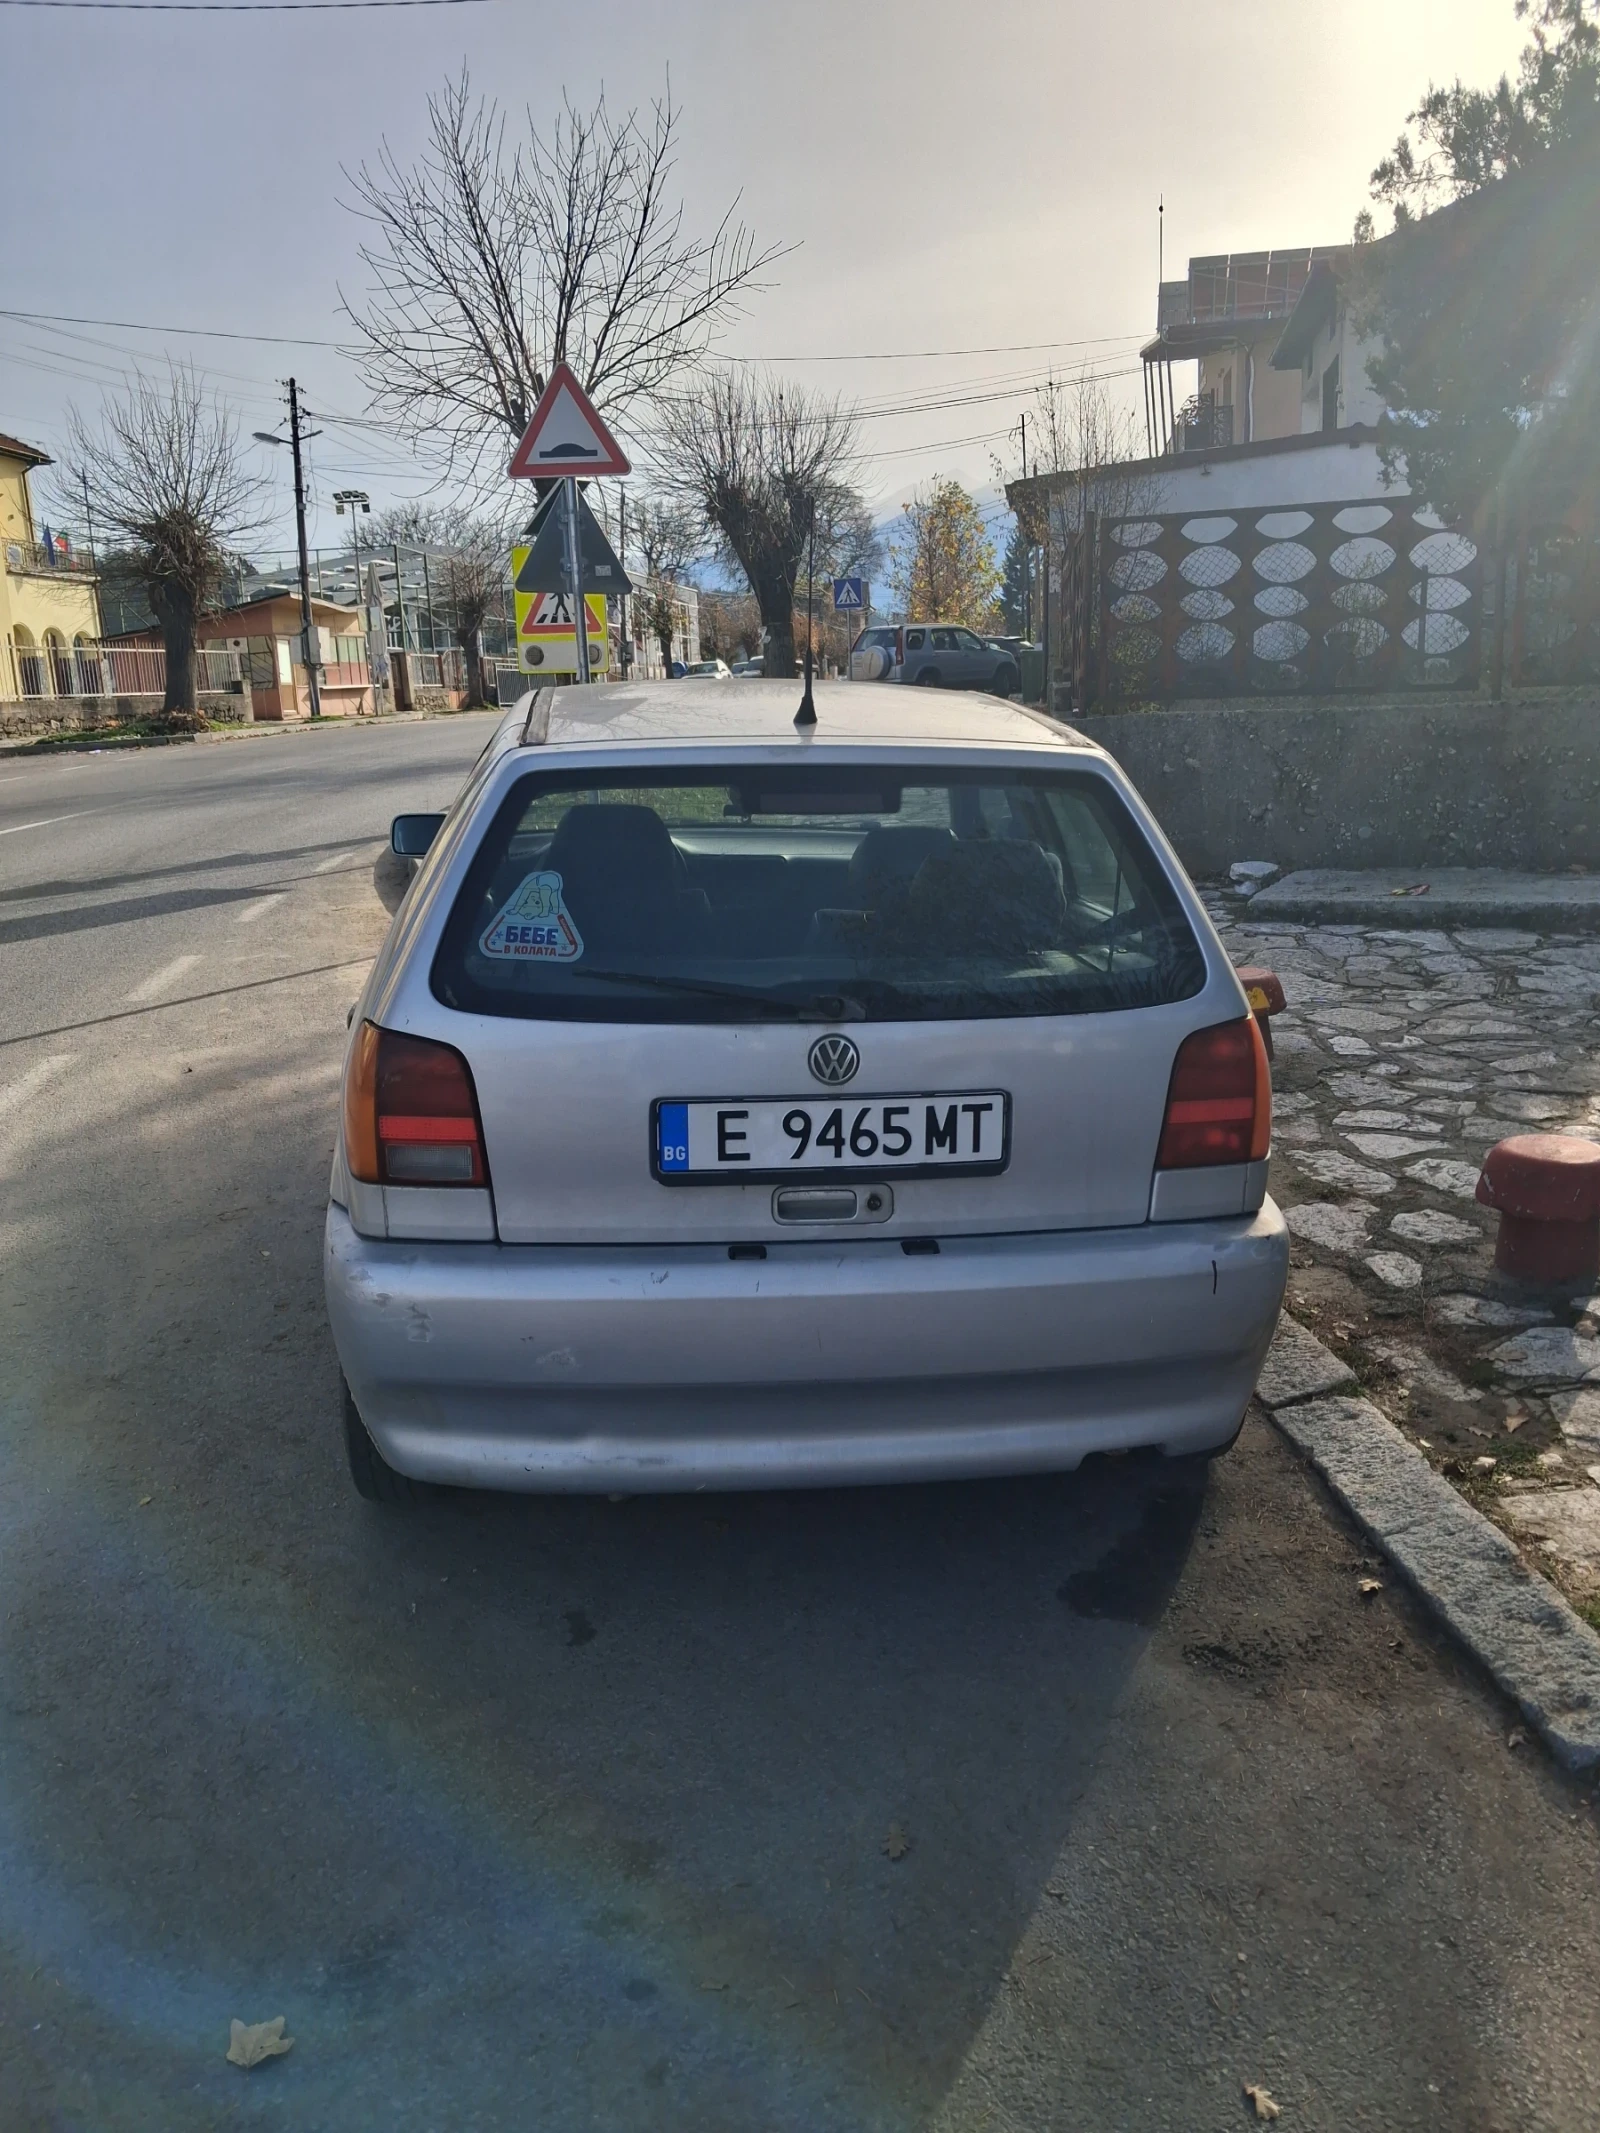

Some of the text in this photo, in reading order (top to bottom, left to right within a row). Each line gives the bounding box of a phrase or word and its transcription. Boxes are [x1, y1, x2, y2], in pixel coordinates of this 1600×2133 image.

[505, 926, 559, 946] БЕБЕ
[504, 945, 557, 957] В КОЛАТА
[717, 1110, 751, 1161] E
[663, 1146, 686, 1161] BG
